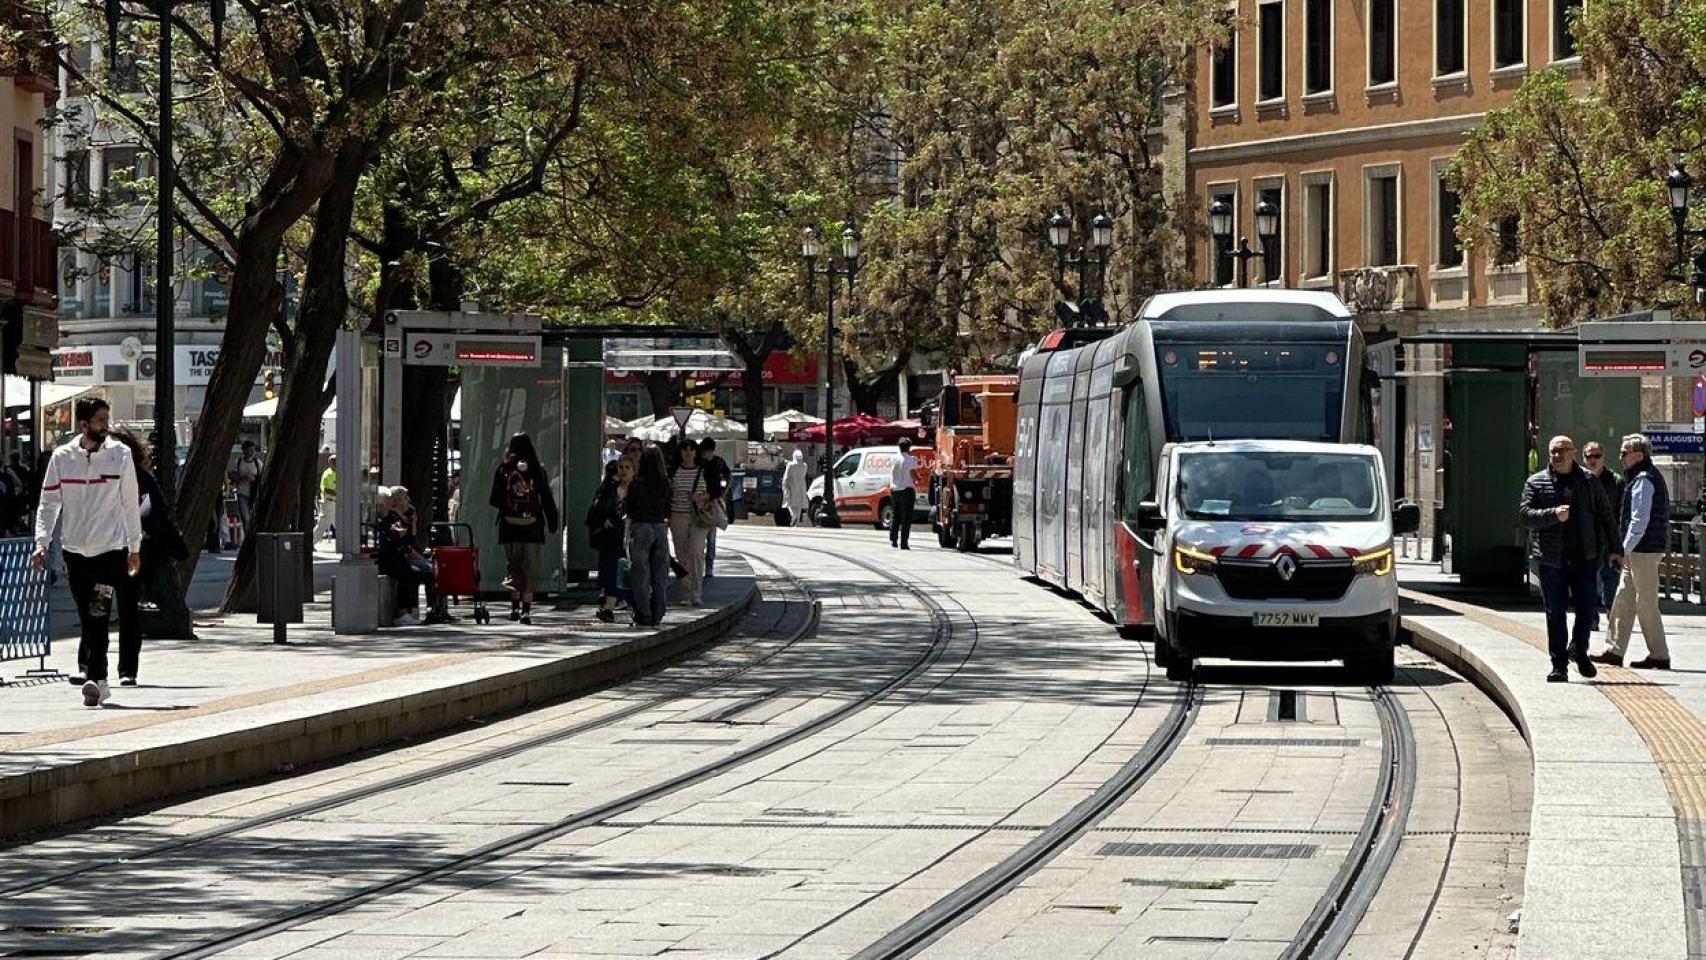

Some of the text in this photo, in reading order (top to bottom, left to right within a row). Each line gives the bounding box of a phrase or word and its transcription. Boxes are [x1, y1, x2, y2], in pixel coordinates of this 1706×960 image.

[1663, 435, 1704, 443] AUGUSTO
[1260, 612, 1316, 625] 7757 MMY
